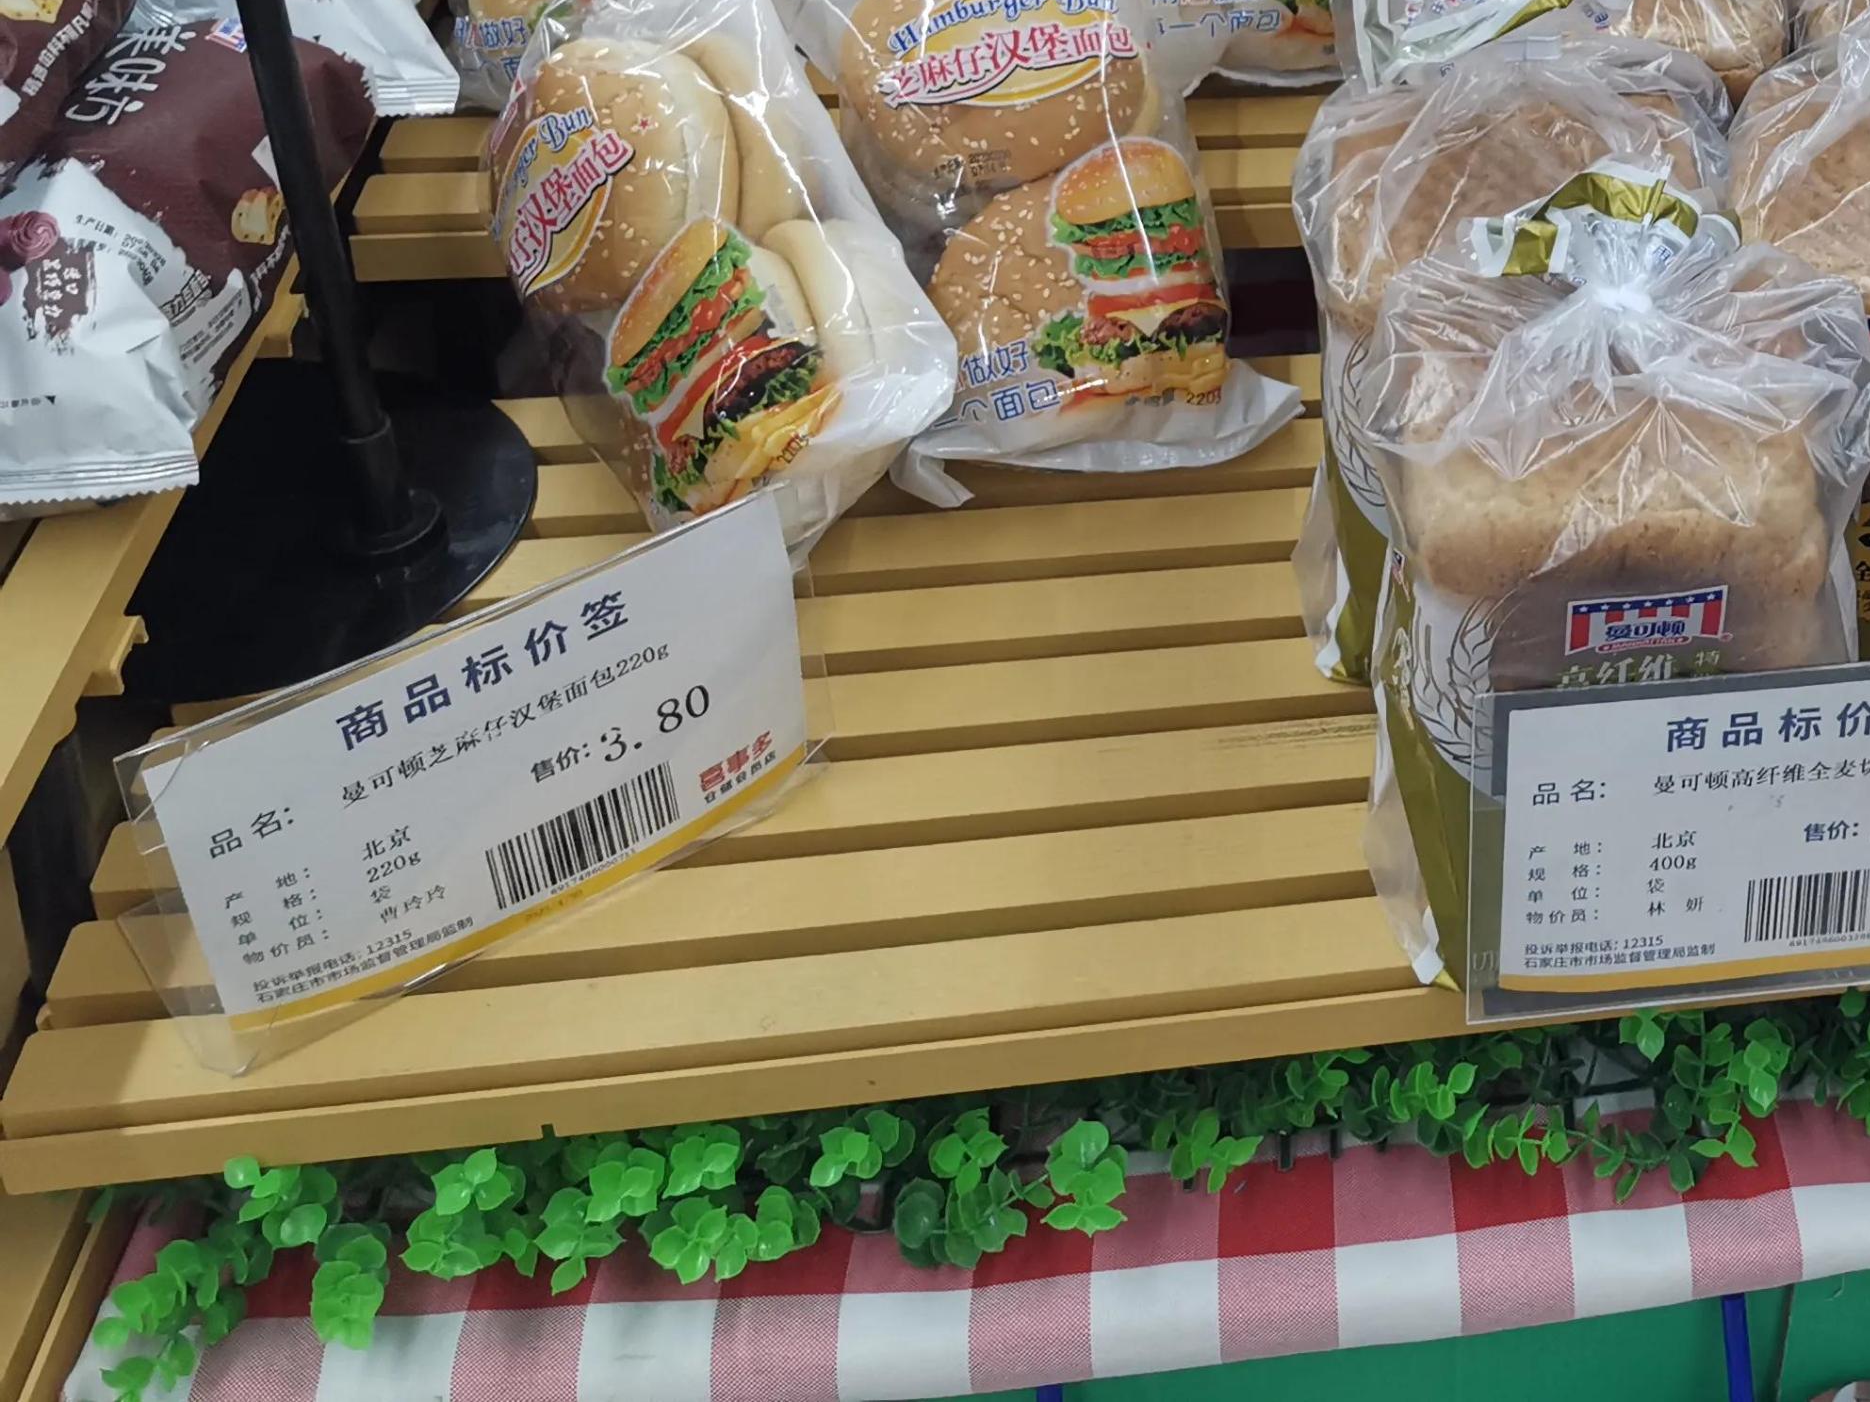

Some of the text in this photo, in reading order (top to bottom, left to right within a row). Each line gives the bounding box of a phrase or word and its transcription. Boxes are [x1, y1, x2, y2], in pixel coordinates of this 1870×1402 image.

[335, 590, 630, 752] 商品标价签
[208, 641, 671, 861] 品名： 曼可顿芝麻仔汉堡面包220g
[529, 683, 711, 786] 售价： 3.80
[697, 731, 776, 795] 喜事多
[1531, 779, 1609, 806] 品名：
[1528, 829, 1698, 860] 产地： 北京
[1803, 819, 1861, 845] 售价：
[223, 825, 415, 912] 产地： 北京
[1527, 852, 1698, 882] 规格： 400g
[230, 849, 422, 929] 规格： 220g
[1527, 877, 1666, 904] 单位： 袋
[236, 908, 326, 948] 单位：
[1526, 906, 1601, 926] 物价员：
[242, 926, 332, 966] 物价员：
[255, 915, 477, 1006] 石家庄市市场监督管理局监制
[1524, 941, 1717, 969] 石家庄市市场监督管理局监制
